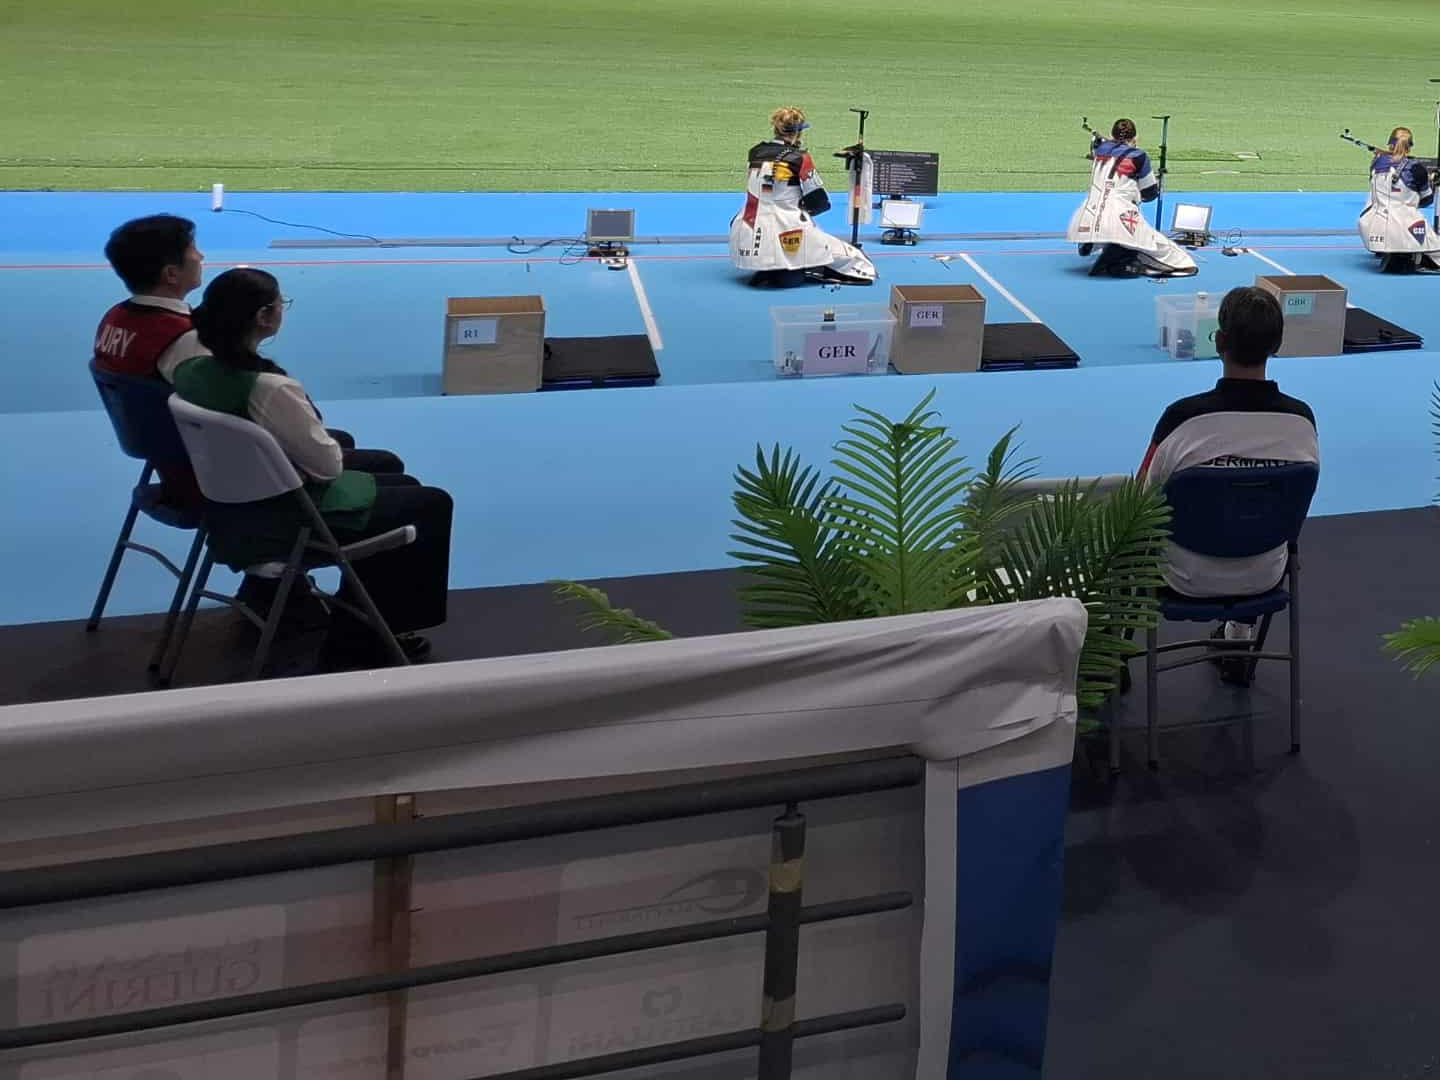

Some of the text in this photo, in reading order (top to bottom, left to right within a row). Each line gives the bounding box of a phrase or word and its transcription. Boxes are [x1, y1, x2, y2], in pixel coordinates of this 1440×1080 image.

[754, 227, 762, 257] ANNA
[916, 311, 938, 320] GER
[819, 345, 856, 359] GER
